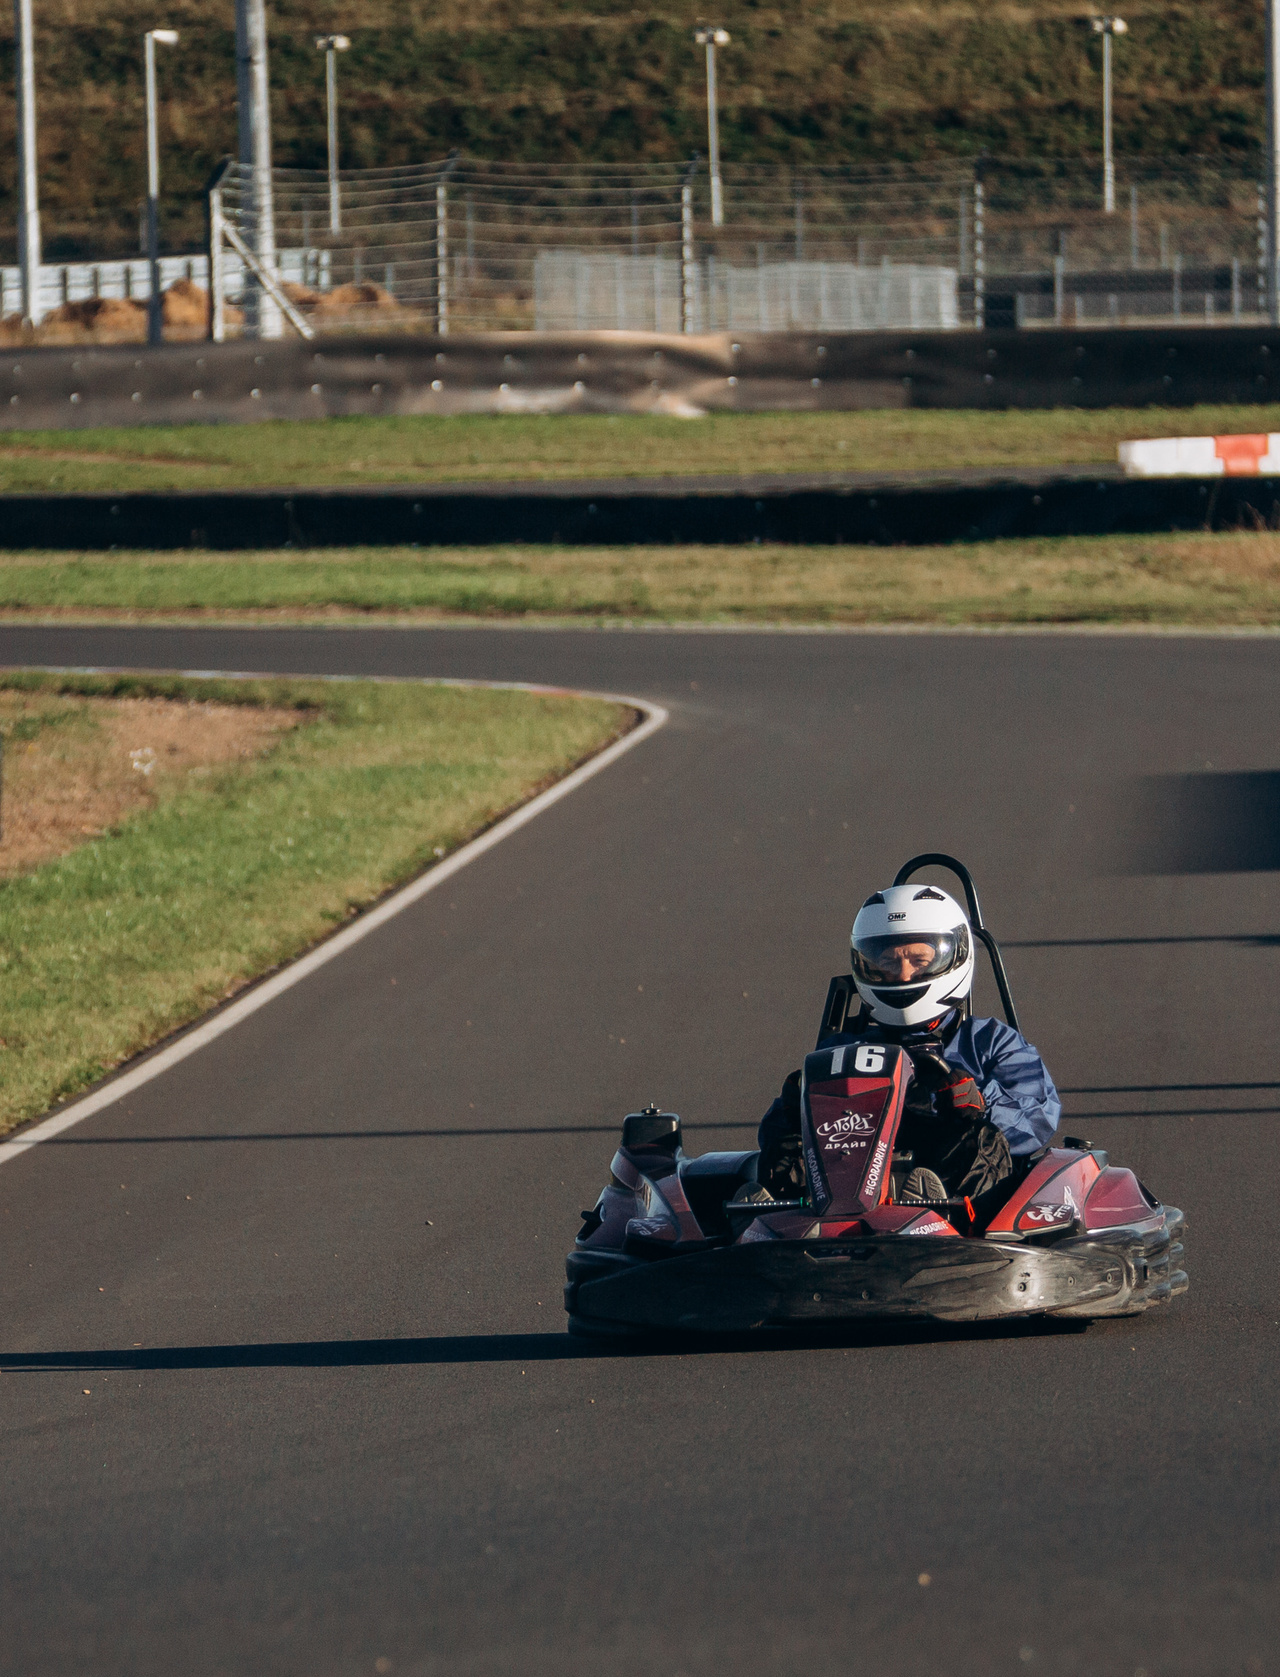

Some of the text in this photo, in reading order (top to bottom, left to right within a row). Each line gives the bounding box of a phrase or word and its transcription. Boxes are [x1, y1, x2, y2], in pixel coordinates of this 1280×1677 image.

[887, 913, 907, 921] OMP
[830, 1046, 886, 1075] 16
[824, 1141, 867, 1150] ДРАЙВ
[864, 1140, 888, 1196] #IGORADRIVE
